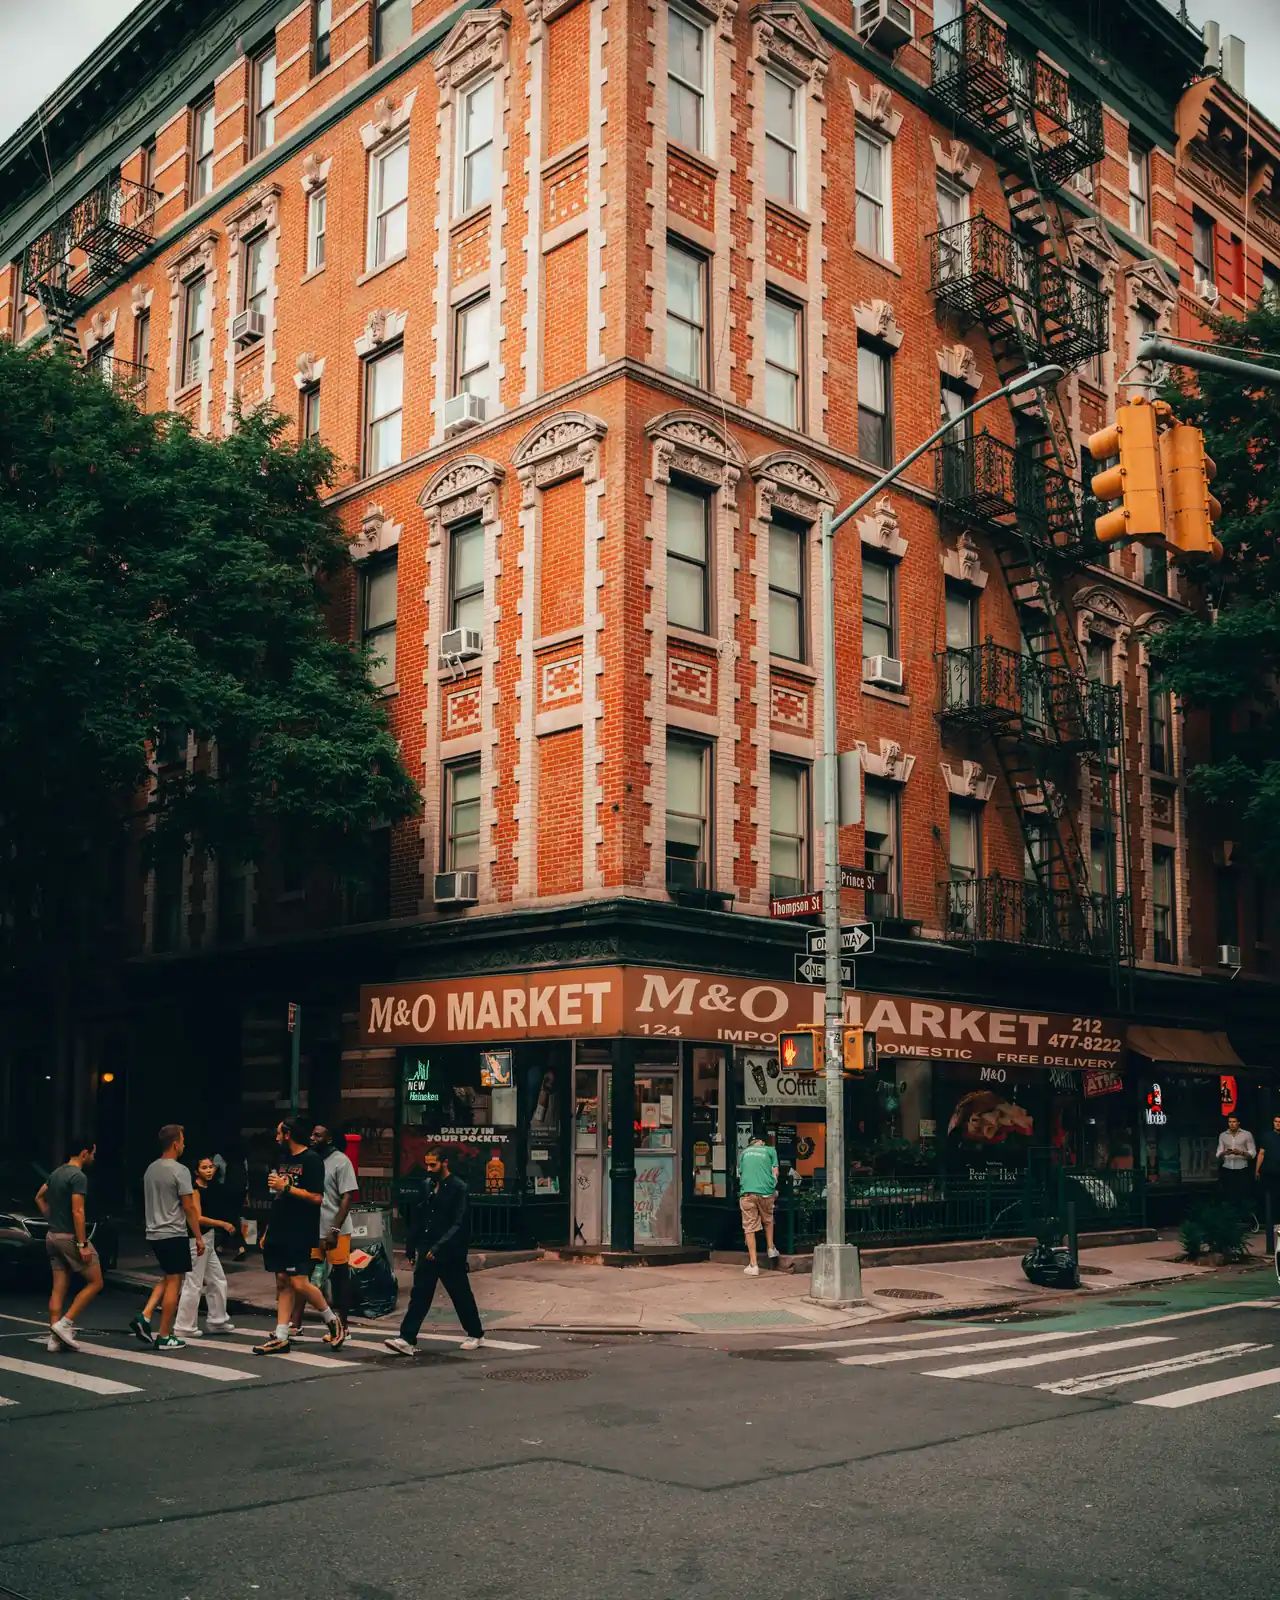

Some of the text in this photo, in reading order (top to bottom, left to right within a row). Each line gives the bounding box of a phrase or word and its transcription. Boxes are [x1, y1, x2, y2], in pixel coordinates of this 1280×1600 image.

[841, 871, 875, 890] Prince St
[772, 896, 820, 916] Thompson St
[842, 933, 864, 947] WAY
[804, 964, 822, 976] ONE
[367, 982, 611, 1033] M&O MARKET
[635, 973, 1049, 1046] M&O MARKET
[639, 1023, 683, 1037] 124
[1072, 1017, 1102, 1033] 212
[1048, 1033, 1122, 1053] 477-8222
[996, 1052, 1117, 1069] FREE DELIVERY
[979, 1066, 1007, 1083] M&O
[407, 1081, 426, 1091] NEW
[409, 1091, 440, 1101] Heineken
[1145, 1108, 1167, 1125] Modelo
[426, 1135, 510, 1143] YOUR POCKET.
[440, 1127, 494, 1136] PARTY IN
